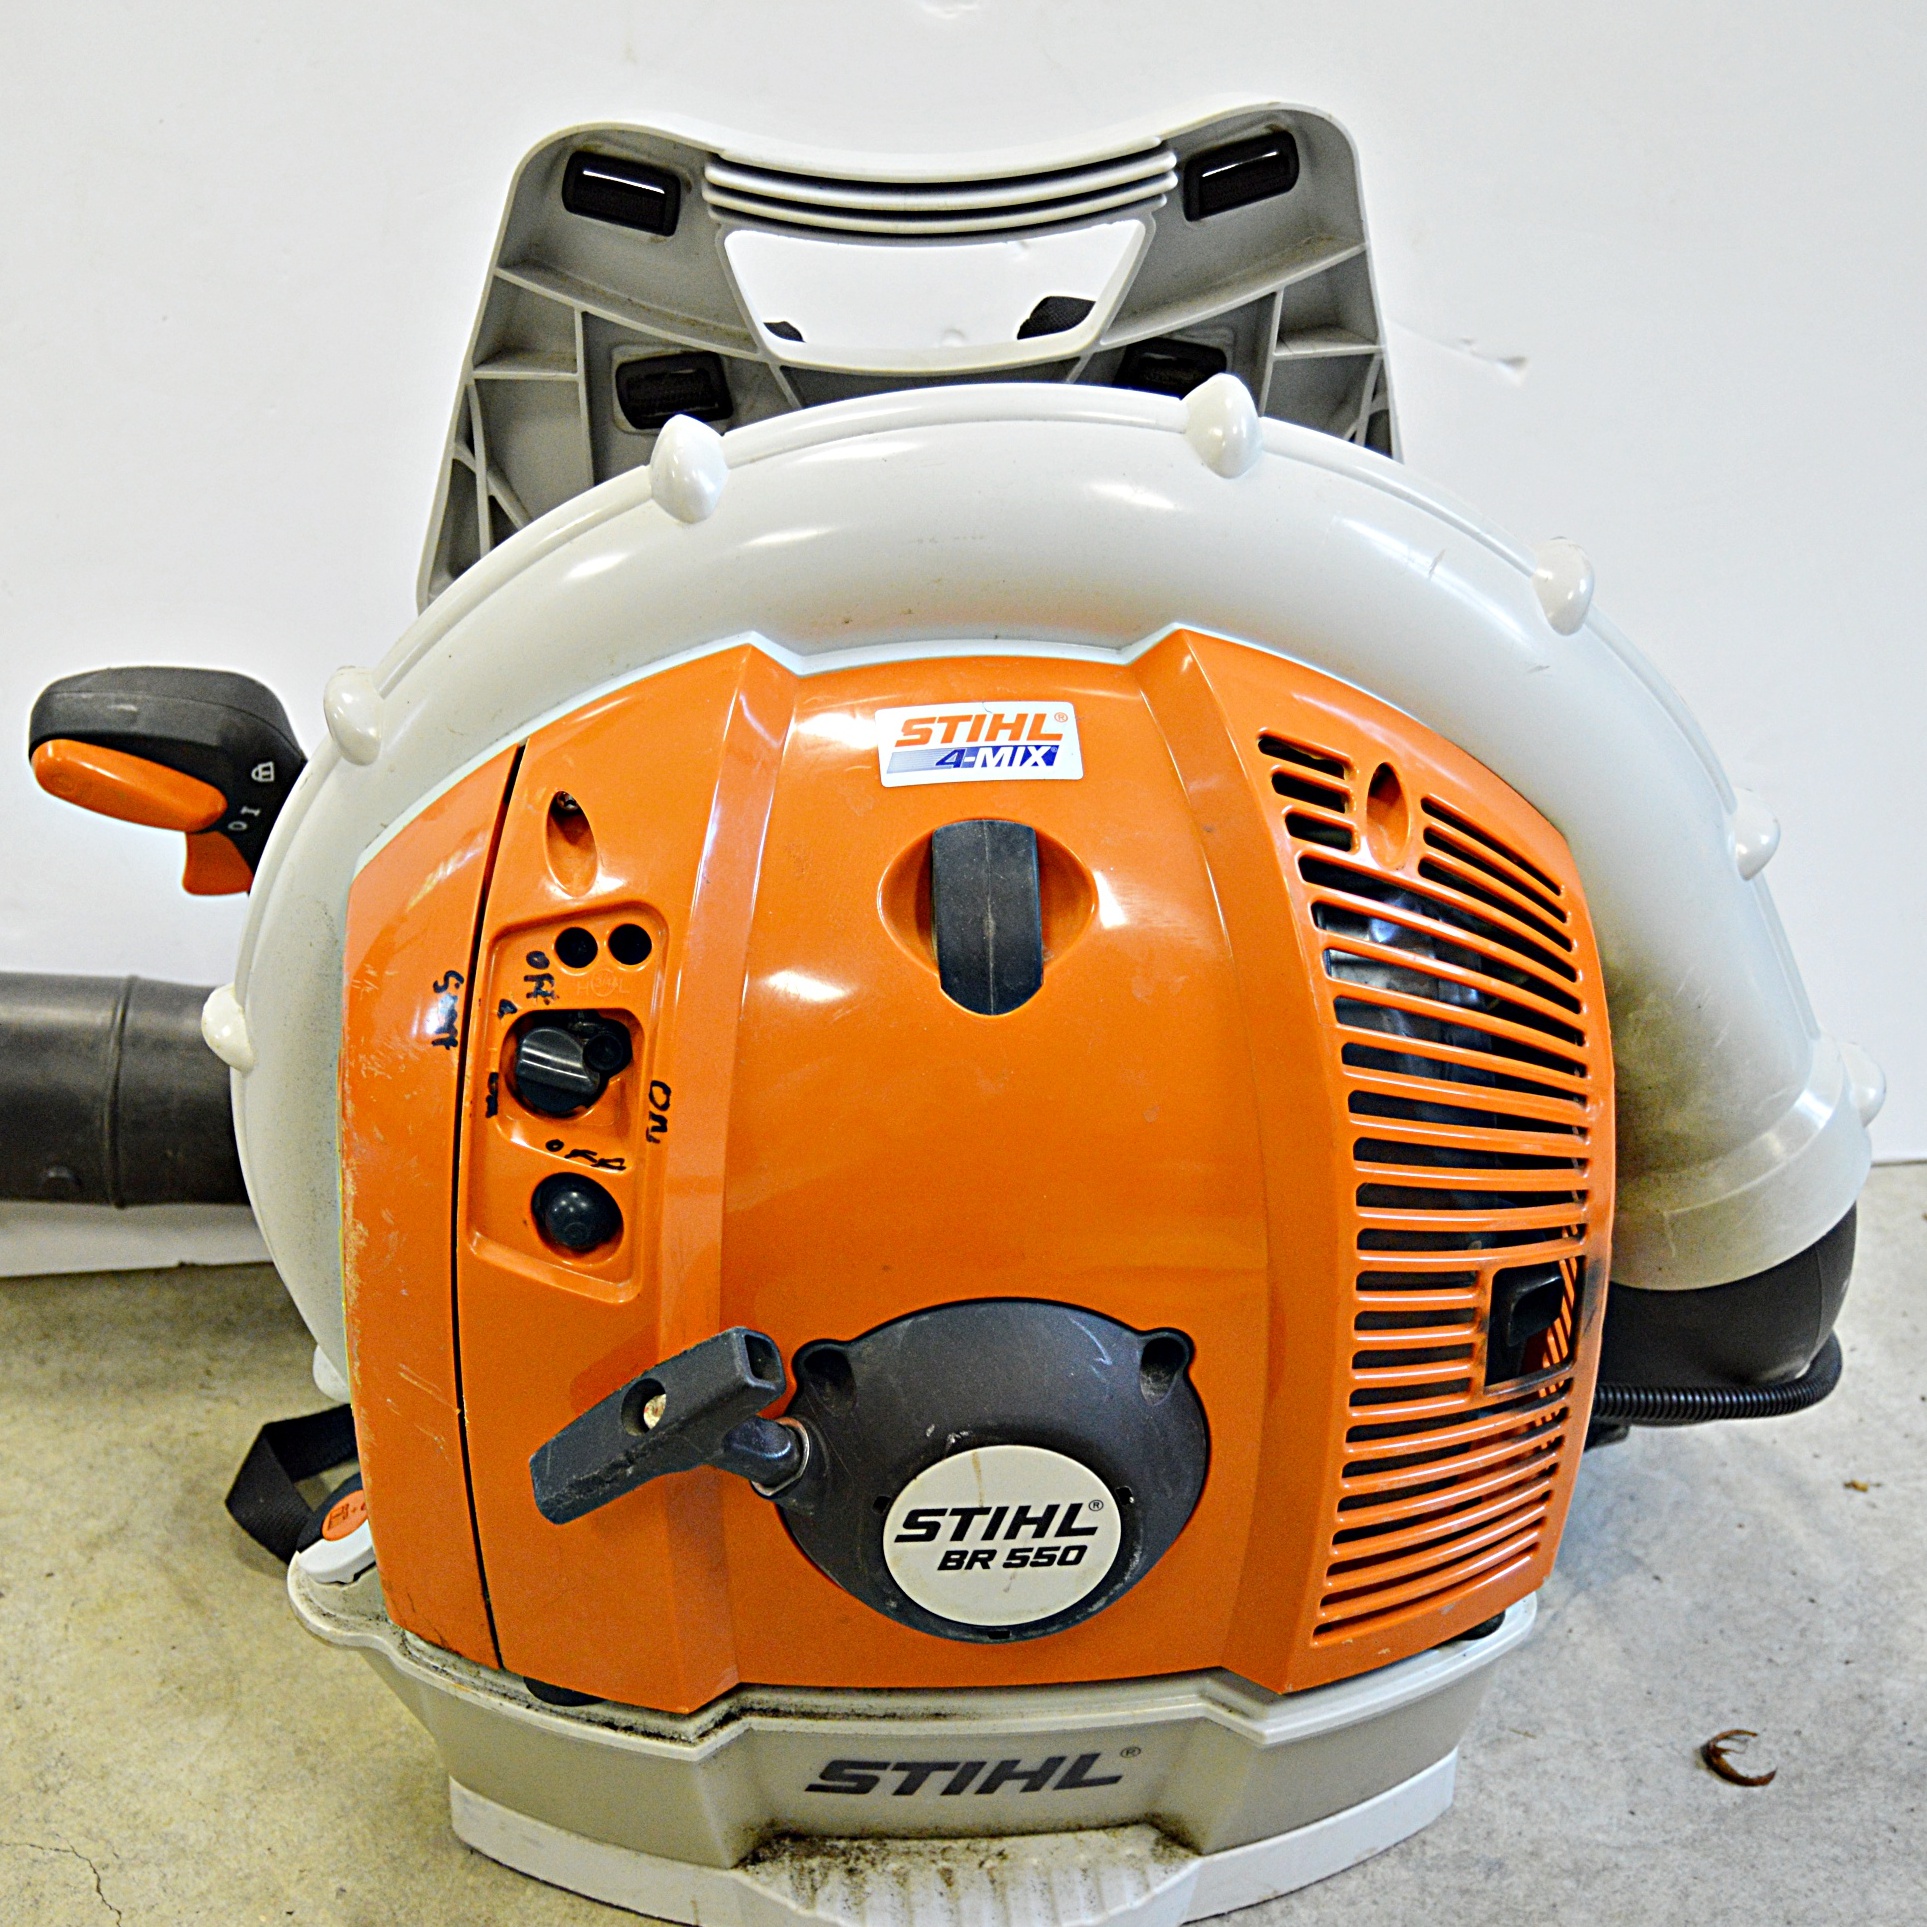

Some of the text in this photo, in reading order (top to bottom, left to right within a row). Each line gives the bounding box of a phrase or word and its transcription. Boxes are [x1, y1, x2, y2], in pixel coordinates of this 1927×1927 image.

[935, 745, 1058, 769] 4-MIX
[937, 1544, 1088, 1571] BR 550
